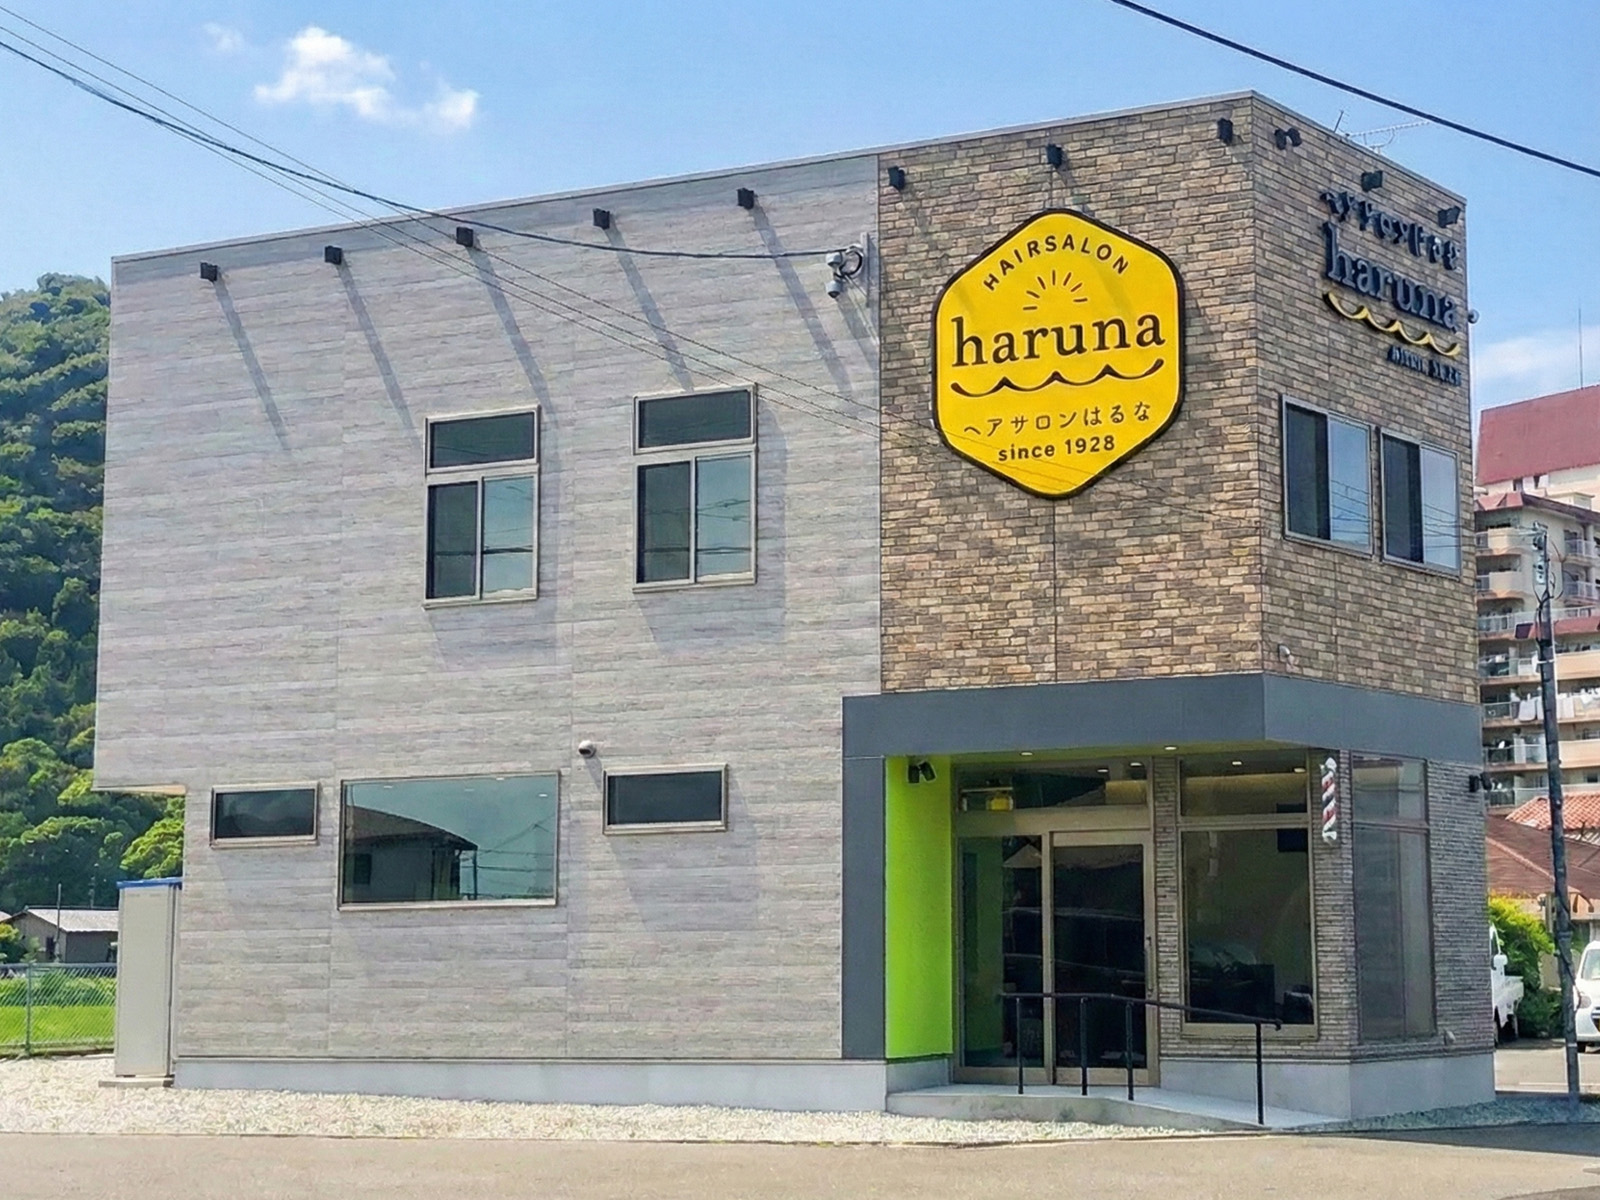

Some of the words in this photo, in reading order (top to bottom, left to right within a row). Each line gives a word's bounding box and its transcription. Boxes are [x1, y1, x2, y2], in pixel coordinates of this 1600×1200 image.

[983, 233, 1129, 291] HAIRSALON
[1322, 221, 1458, 333] haruna
[951, 313, 1166, 368] haruna
[963, 401, 1151, 437] ヘアサロンはるな
[998, 443, 1056, 462] since
[1064, 434, 1116, 455] 1928
